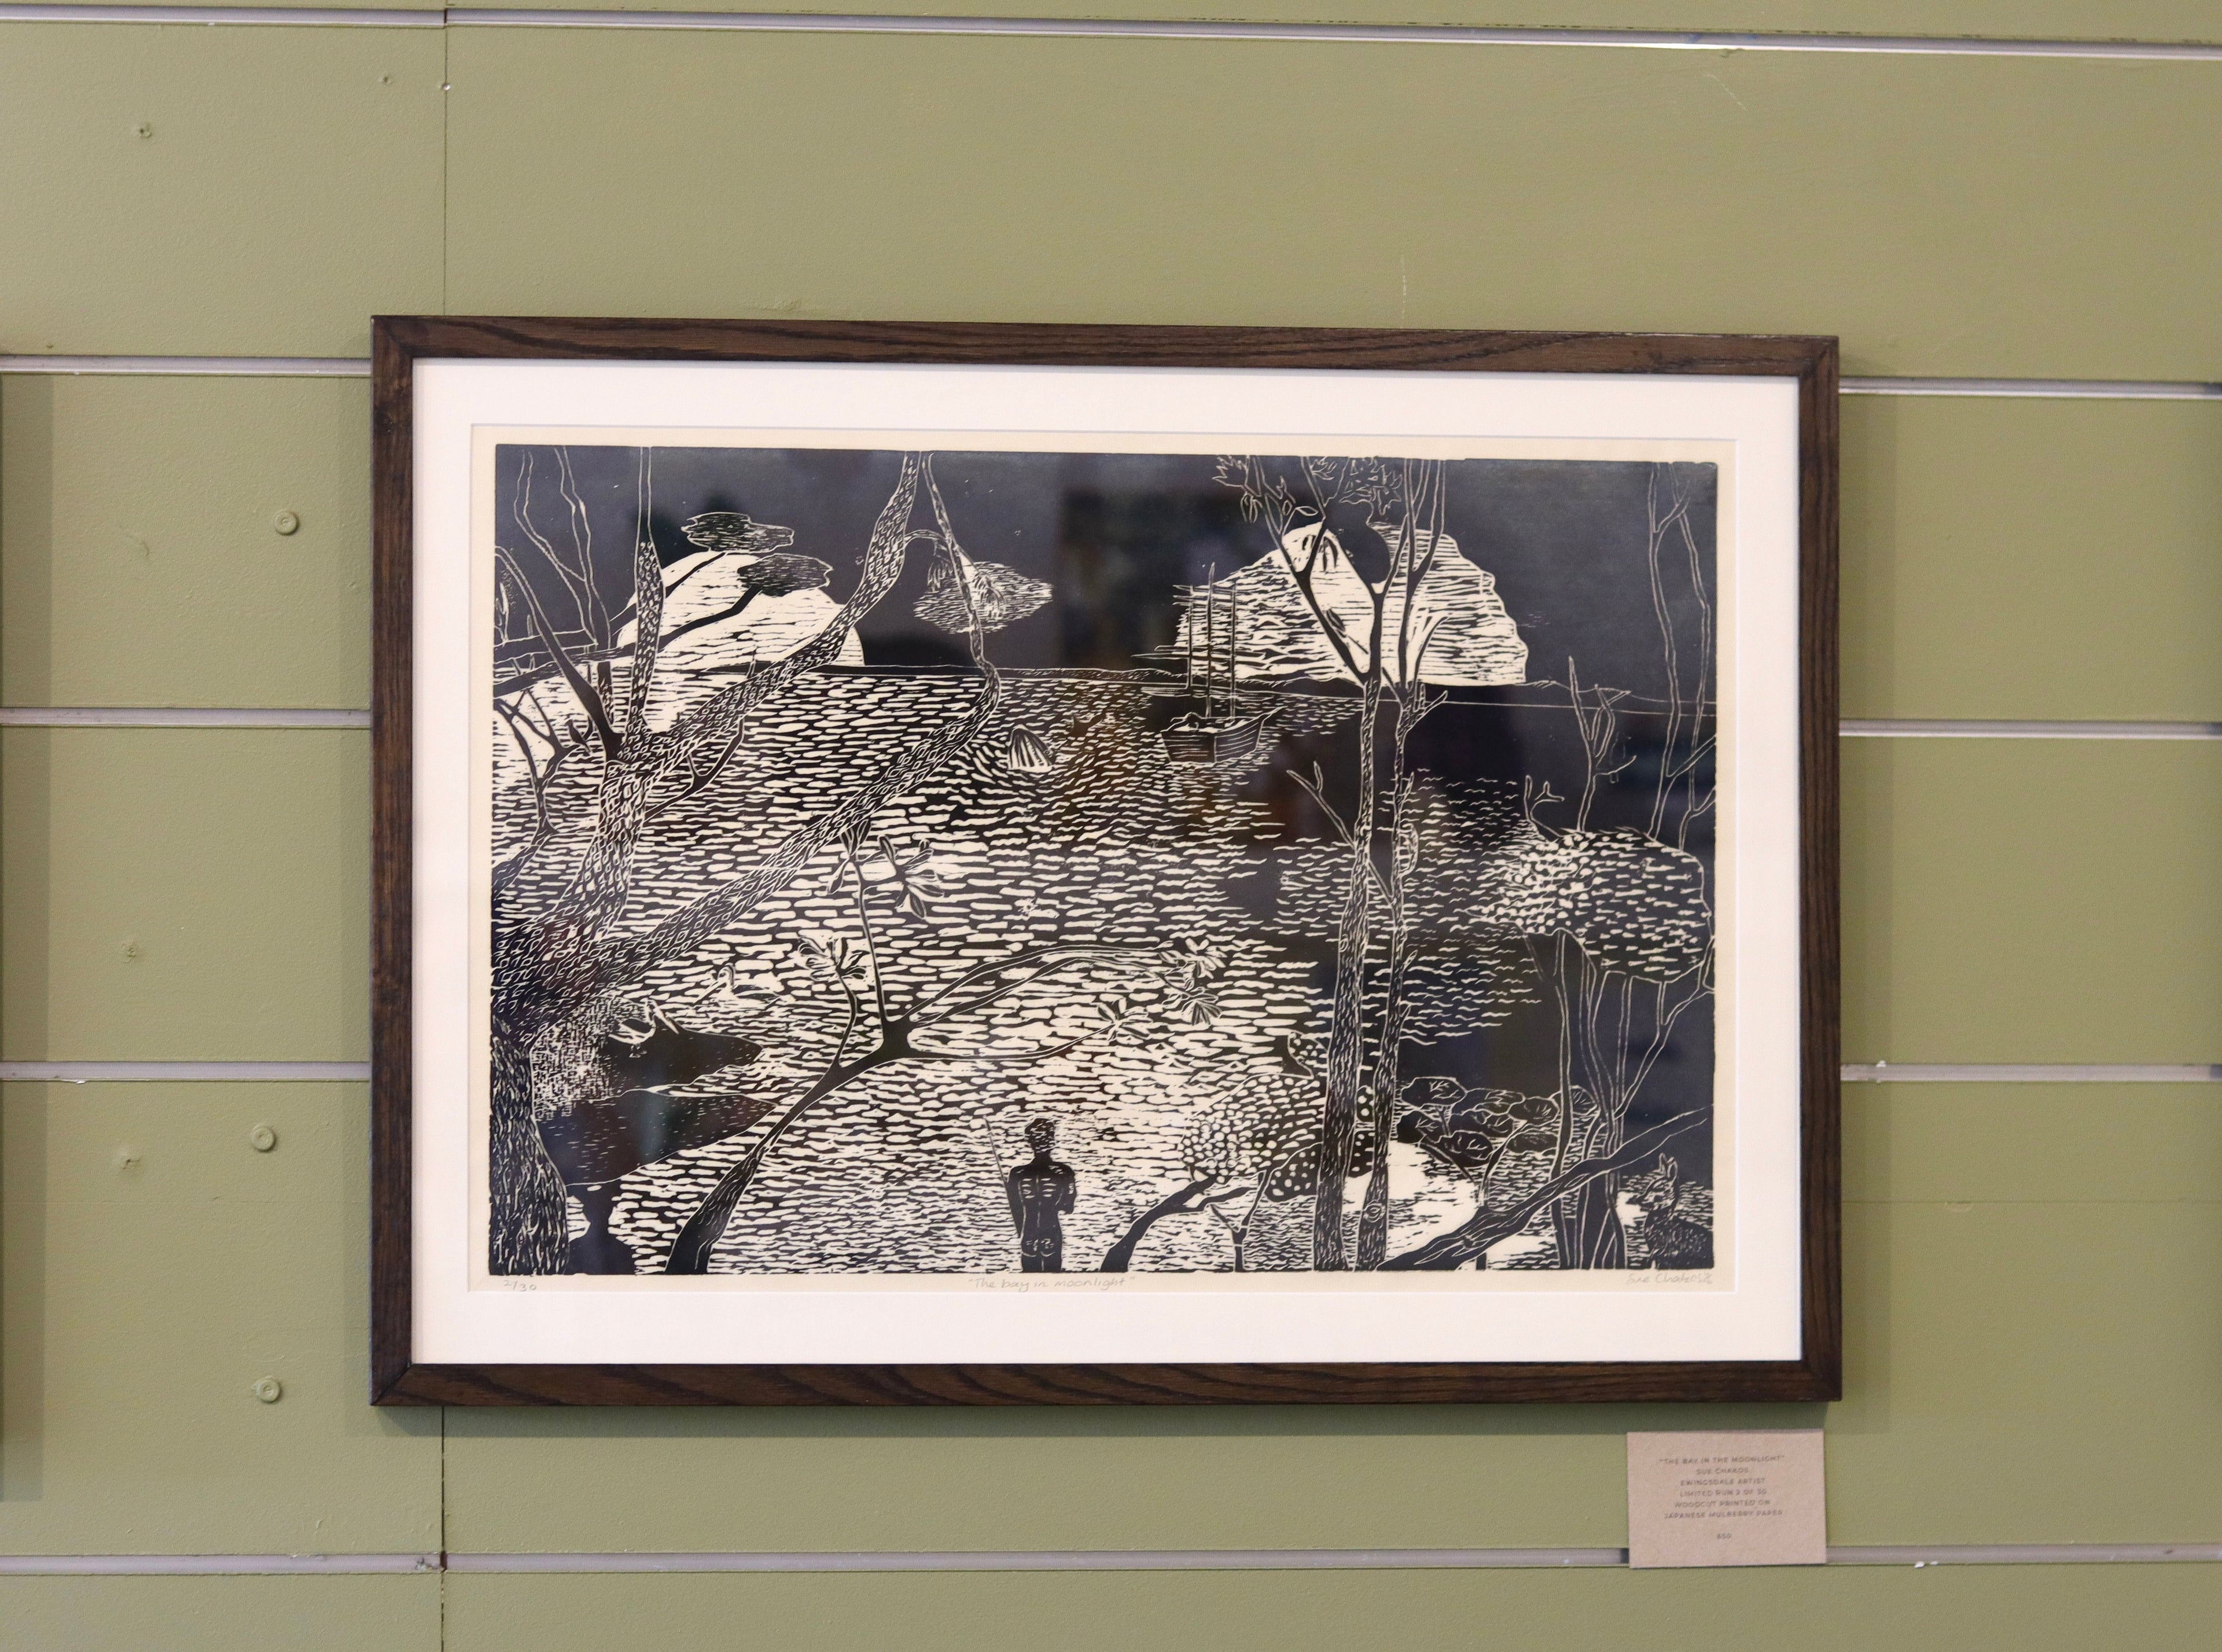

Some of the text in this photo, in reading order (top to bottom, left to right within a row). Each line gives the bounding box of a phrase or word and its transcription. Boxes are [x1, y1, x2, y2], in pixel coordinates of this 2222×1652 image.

[1001, 1278, 1029, 1292] bay
[1033, 1279, 1048, 1287] in
[1680, 1477, 1766, 1487] EWINGSDALE ARTIST
[1679, 1489, 1713, 1498] LIMITED
[1664, 1511, 1705, 1519] JAPANESE
